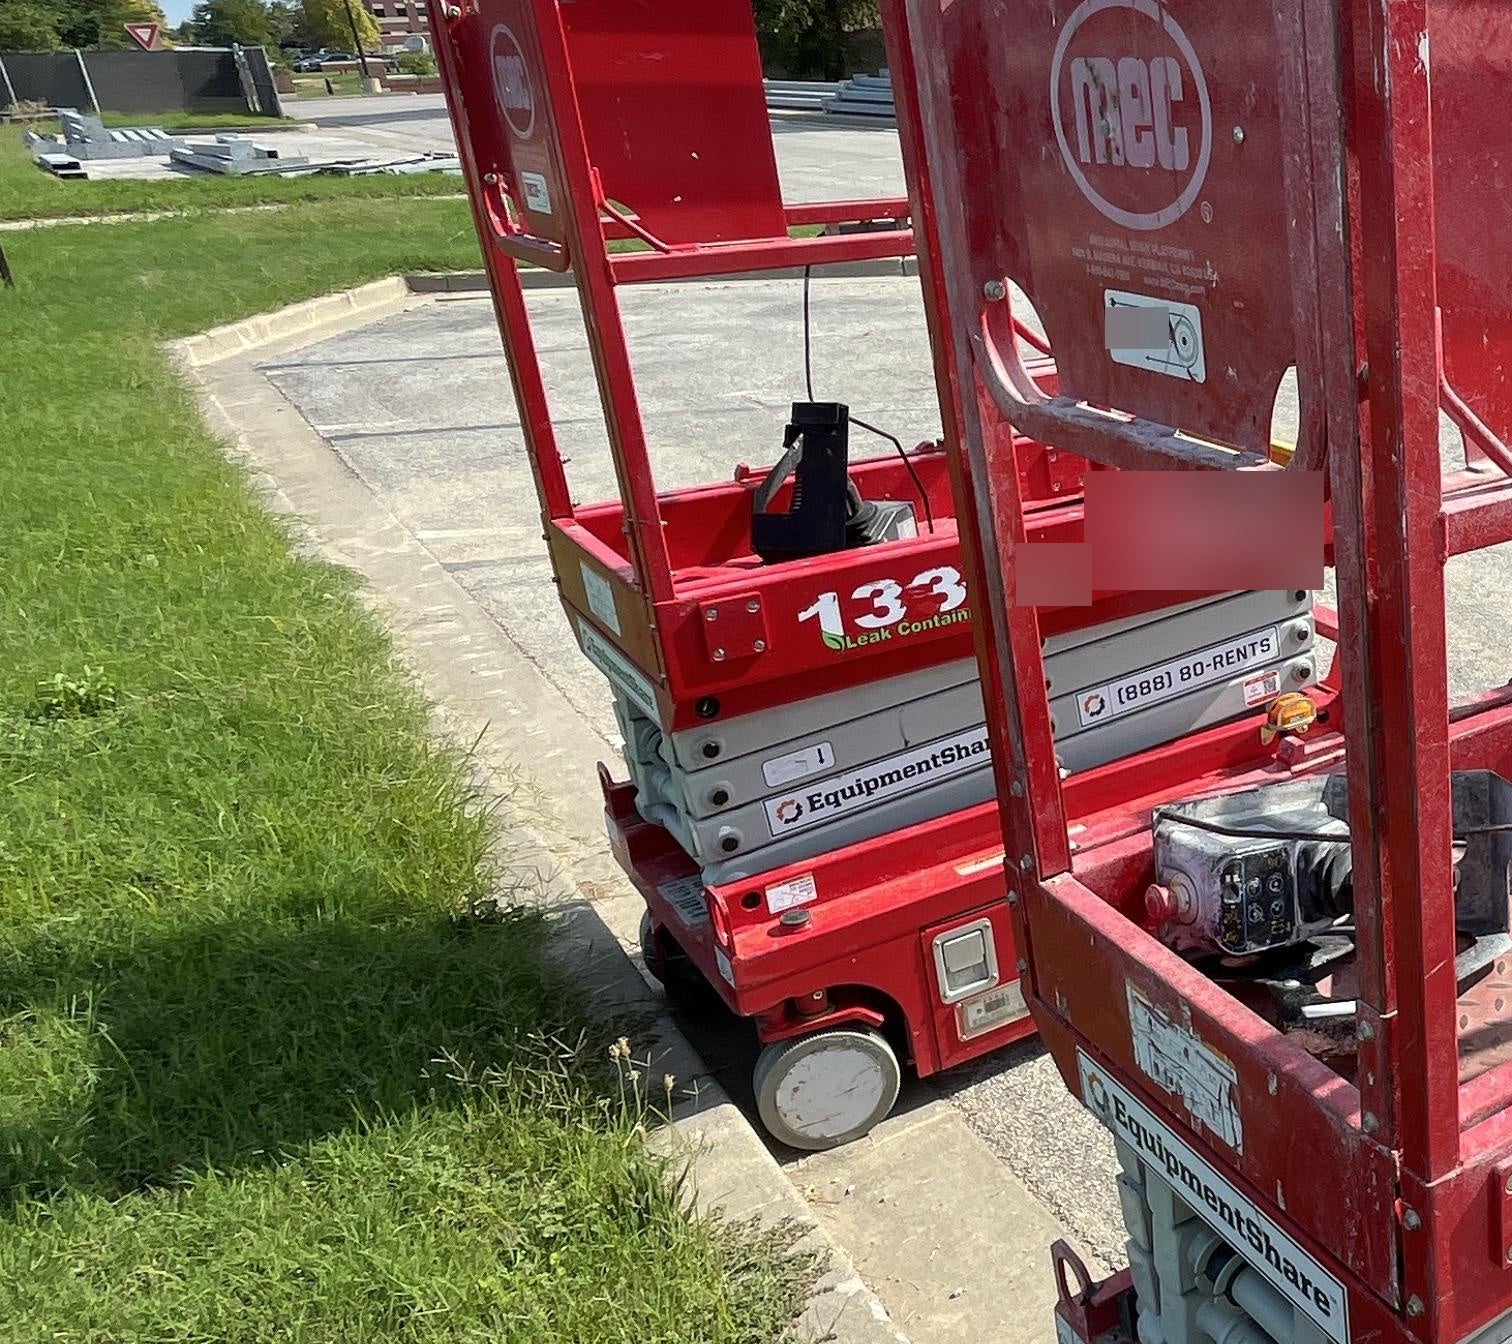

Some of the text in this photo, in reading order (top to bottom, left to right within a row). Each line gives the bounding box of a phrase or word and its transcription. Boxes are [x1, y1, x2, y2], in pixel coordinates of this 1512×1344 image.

[798, 566, 967, 638] 133
[846, 607, 972, 650] Leak Contain
[1179, 637, 1271, 682] 80-RENTS
[1111, 1093, 1331, 1317] EquipmentShare
